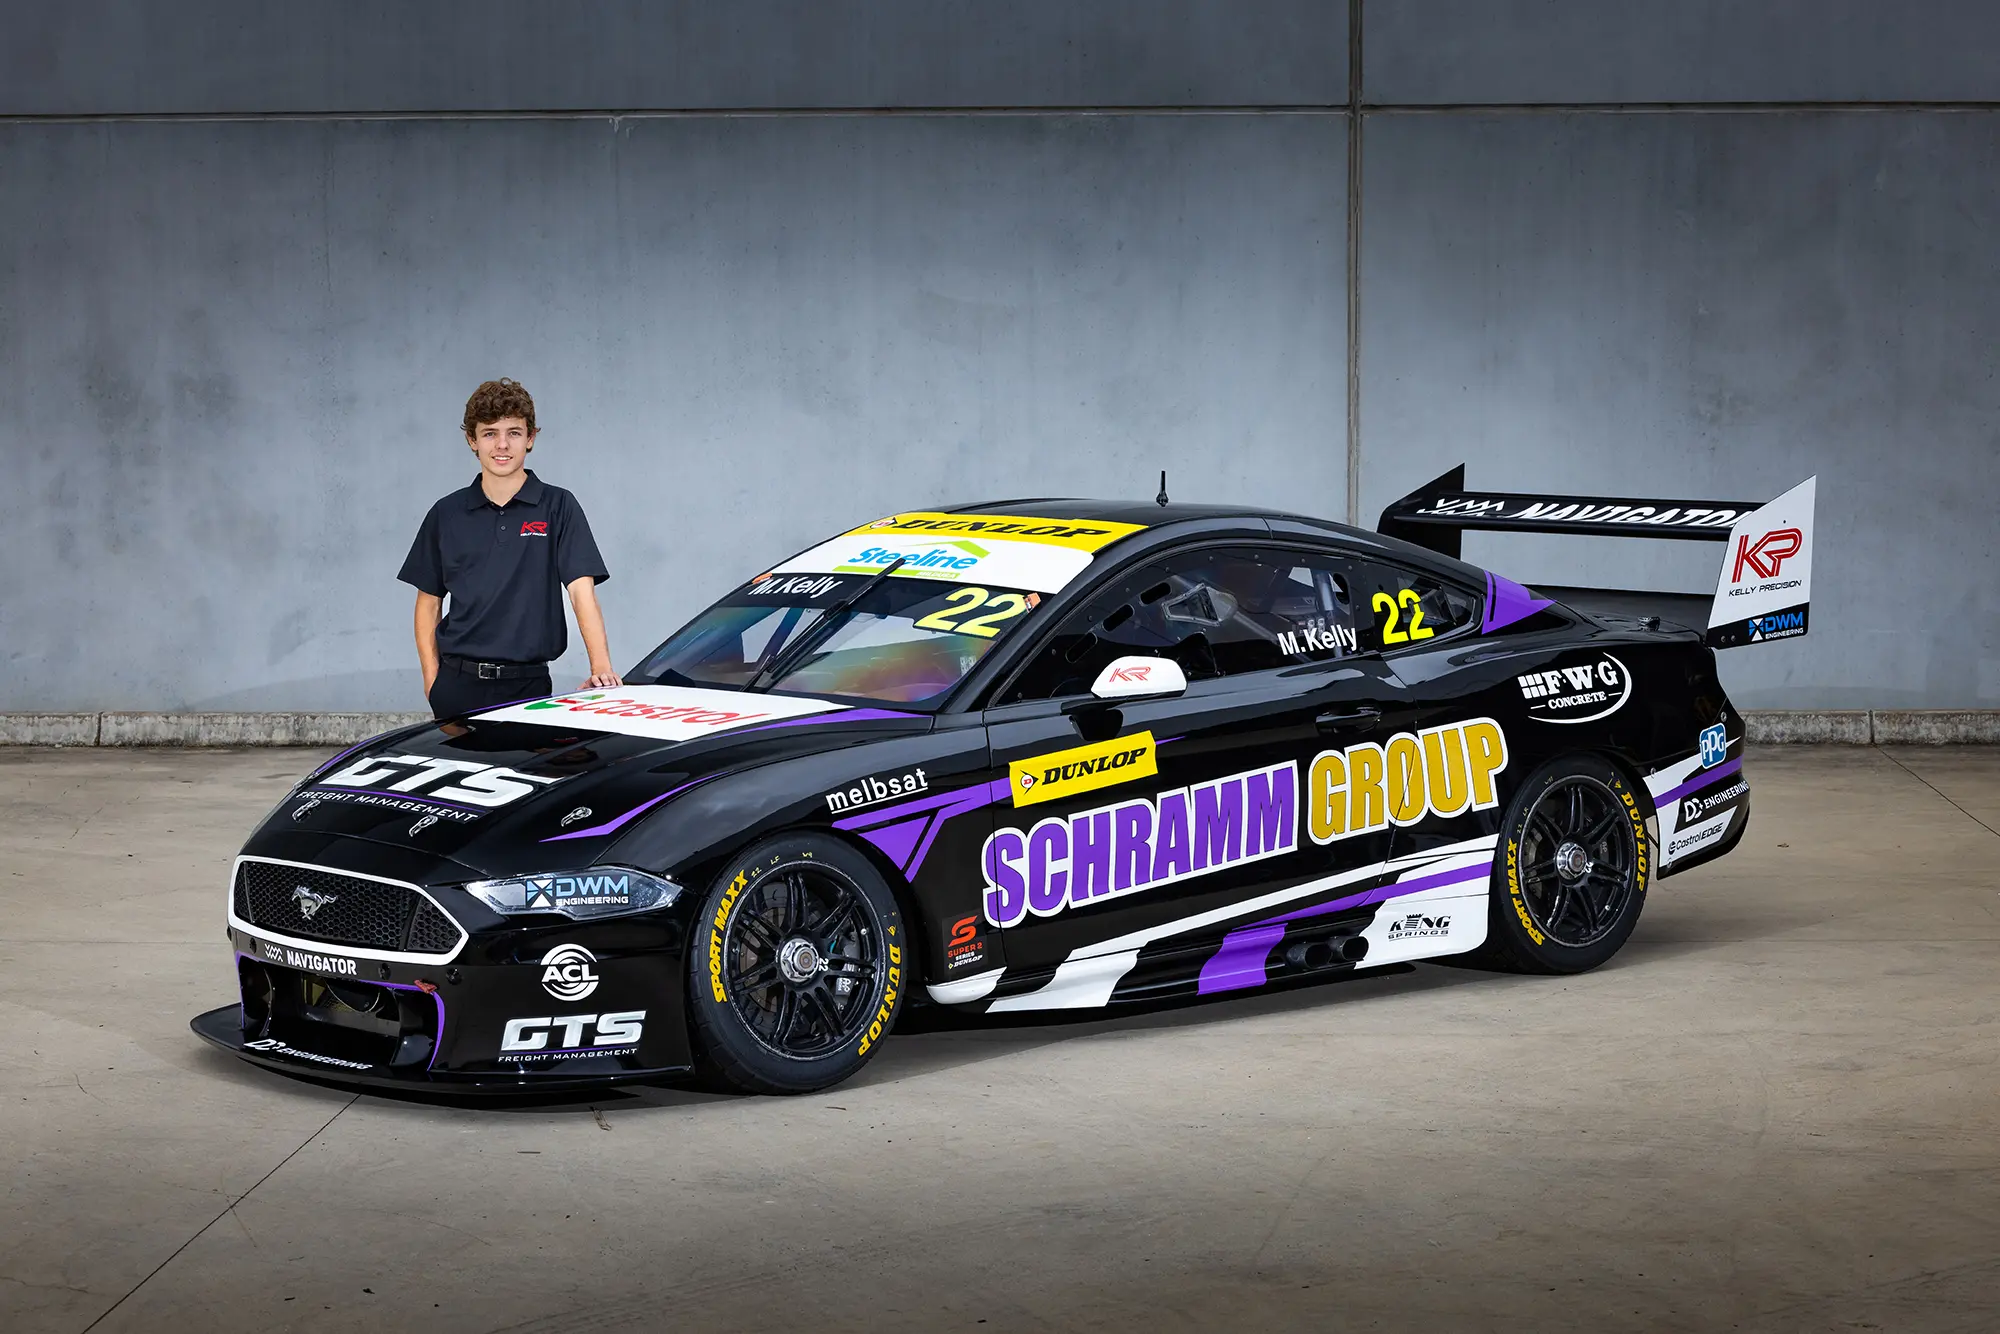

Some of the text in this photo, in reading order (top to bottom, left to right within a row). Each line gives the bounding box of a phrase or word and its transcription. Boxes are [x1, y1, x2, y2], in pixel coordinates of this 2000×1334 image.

[520, 521, 548, 534] KR
[893, 519, 1111, 538] DUNLOP
[848, 547, 978, 569] Steeline
[1732, 528, 1802, 583] KP
[1729, 580, 1802, 597] KELLY PRECISION
[913, 587, 1026, 638] 22
[1372, 588, 1434, 645] 22
[1765, 612, 1803, 632] DWM
[1765, 628, 1803, 639] ENGINEERING
[1109, 666, 1151, 682] KR
[569, 699, 772, 726] Castrol
[1548, 691, 1607, 709] CONCRETE
[1701, 731, 1724, 762] PPG
[1042, 747, 1147, 786] DUNLOP
[319, 755, 565, 806] GTS
[825, 768, 928, 812] melbsat
[1309, 720, 1506, 843] GROUP
[296, 791, 478, 822] FREIGHT MANAGEMENT
[1704, 780, 1750, 809] ENGINEERING
[982, 762, 1297, 926] SCHRAMM
[1621, 792, 1647, 892] DUNLOP
[556, 876, 628, 897] DWM
[1507, 838, 1545, 945] SPORT MAXX
[556, 896, 629, 906] ENGINEERING
[709, 869, 748, 1003] SPORT MAXX
[1388, 930, 1449, 939] SPRINGS
[947, 941, 983, 958] SUPER 2
[954, 954, 983, 967] DUNLOP
[286, 950, 357, 975] NAVIGATOR
[541, 964, 599, 982] ACL
[819, 957, 829, 971] 22
[858, 943, 901, 1056] DUNLOP
[501, 1010, 647, 1051] GTS
[277, 1047, 373, 1070] ENGINEERING
[499, 1048, 638, 1063] FREIGHT MANAGEMENT
